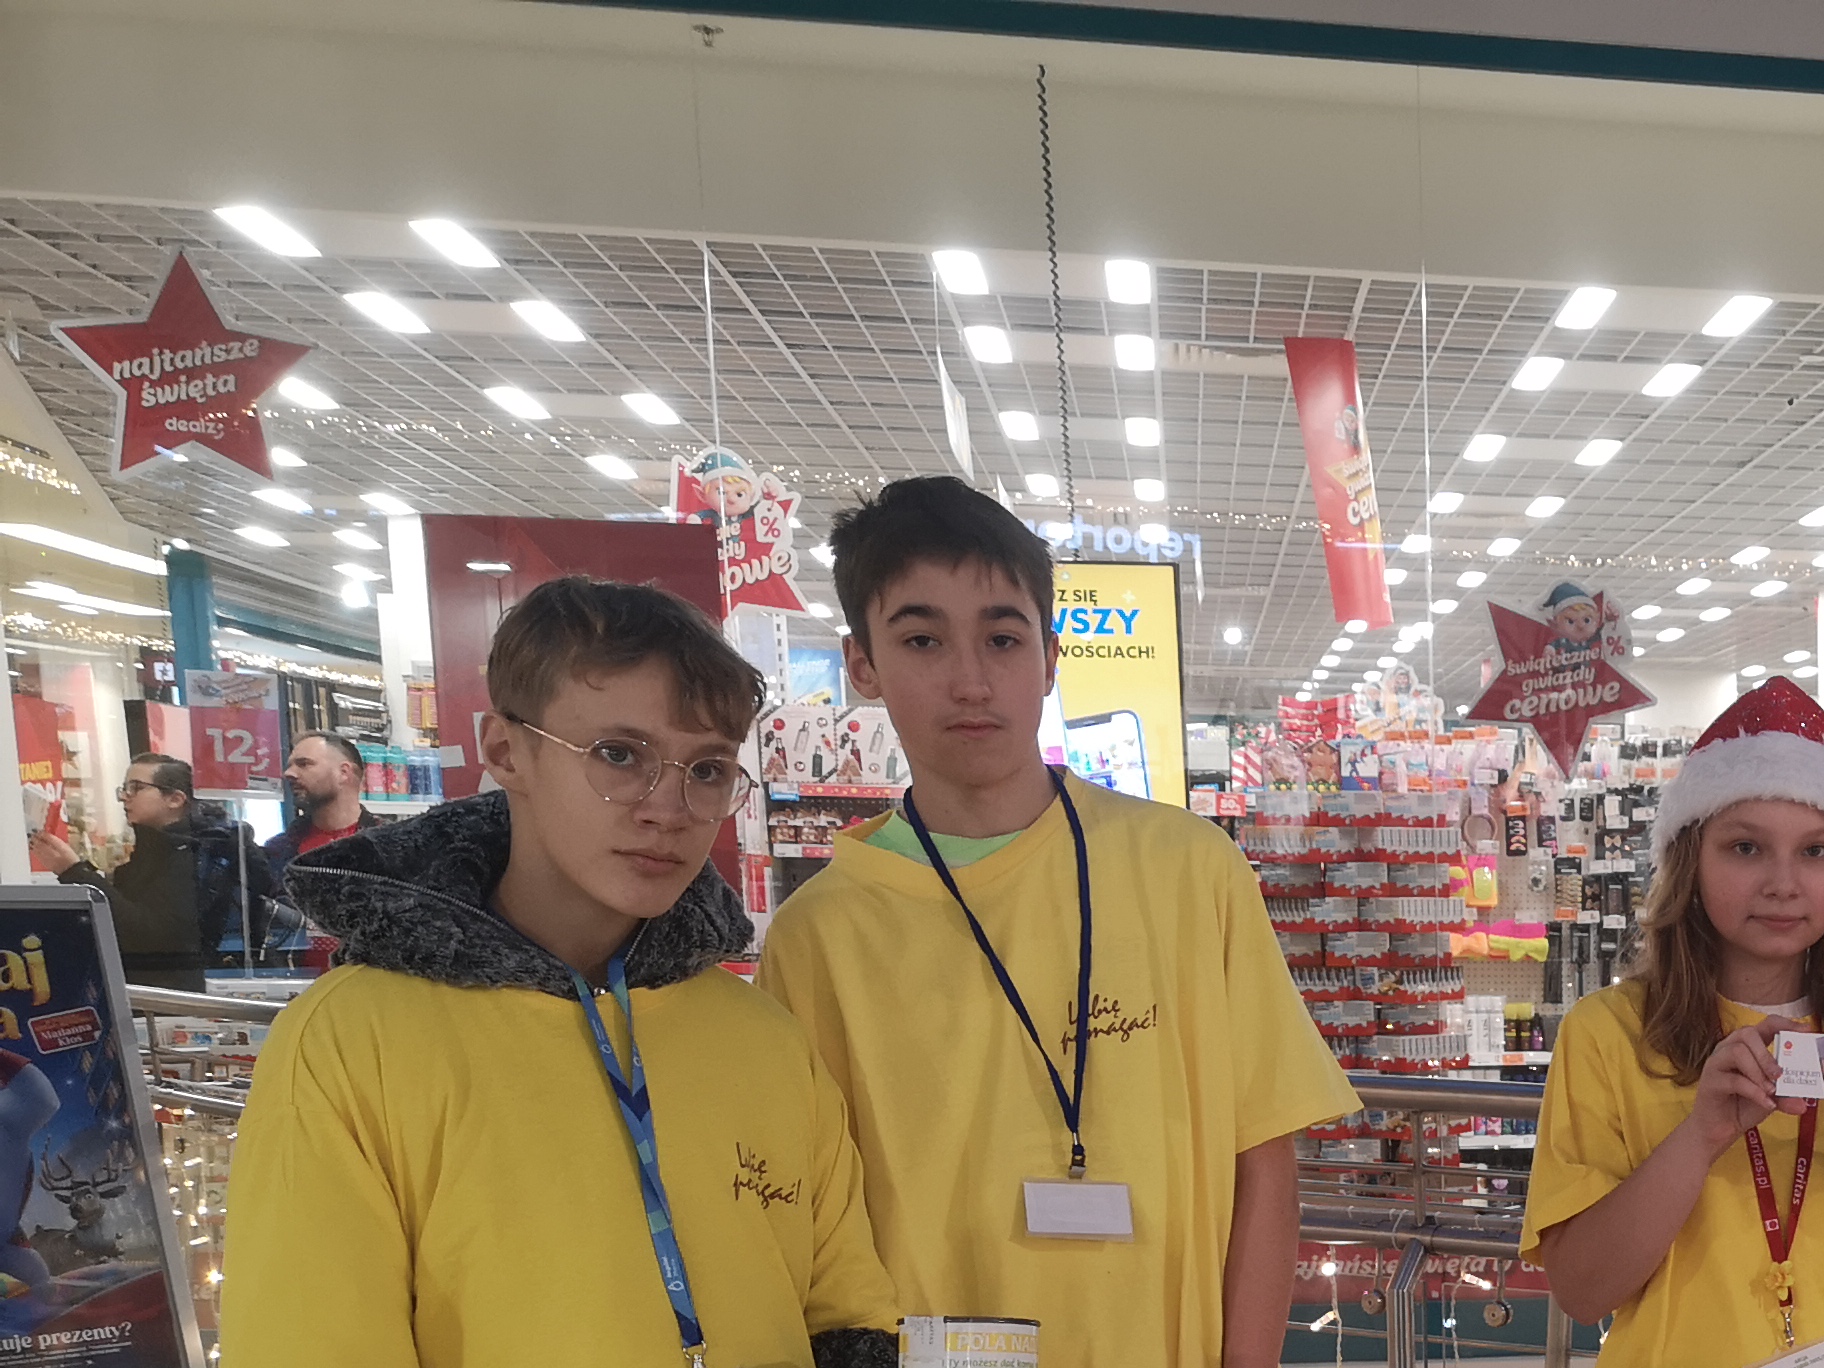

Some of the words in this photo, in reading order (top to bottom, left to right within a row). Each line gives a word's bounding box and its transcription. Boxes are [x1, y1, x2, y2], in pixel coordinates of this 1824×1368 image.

[113, 338, 260, 380] najtańsze
[141, 373, 236, 407] święta
[1073, 590, 1098, 606] SIĘ
[1507, 646, 1600, 676] świąteczne
[1522, 665, 1595, 696] gwiazdy
[1503, 681, 1621, 719] cenowe
[1747, 1130, 1771, 1189] caritas.pl
[1792, 1157, 1807, 1206] caritas
[38, 1321, 132, 1350] prezenty?
[957, 1334, 1006, 1351] POLA
